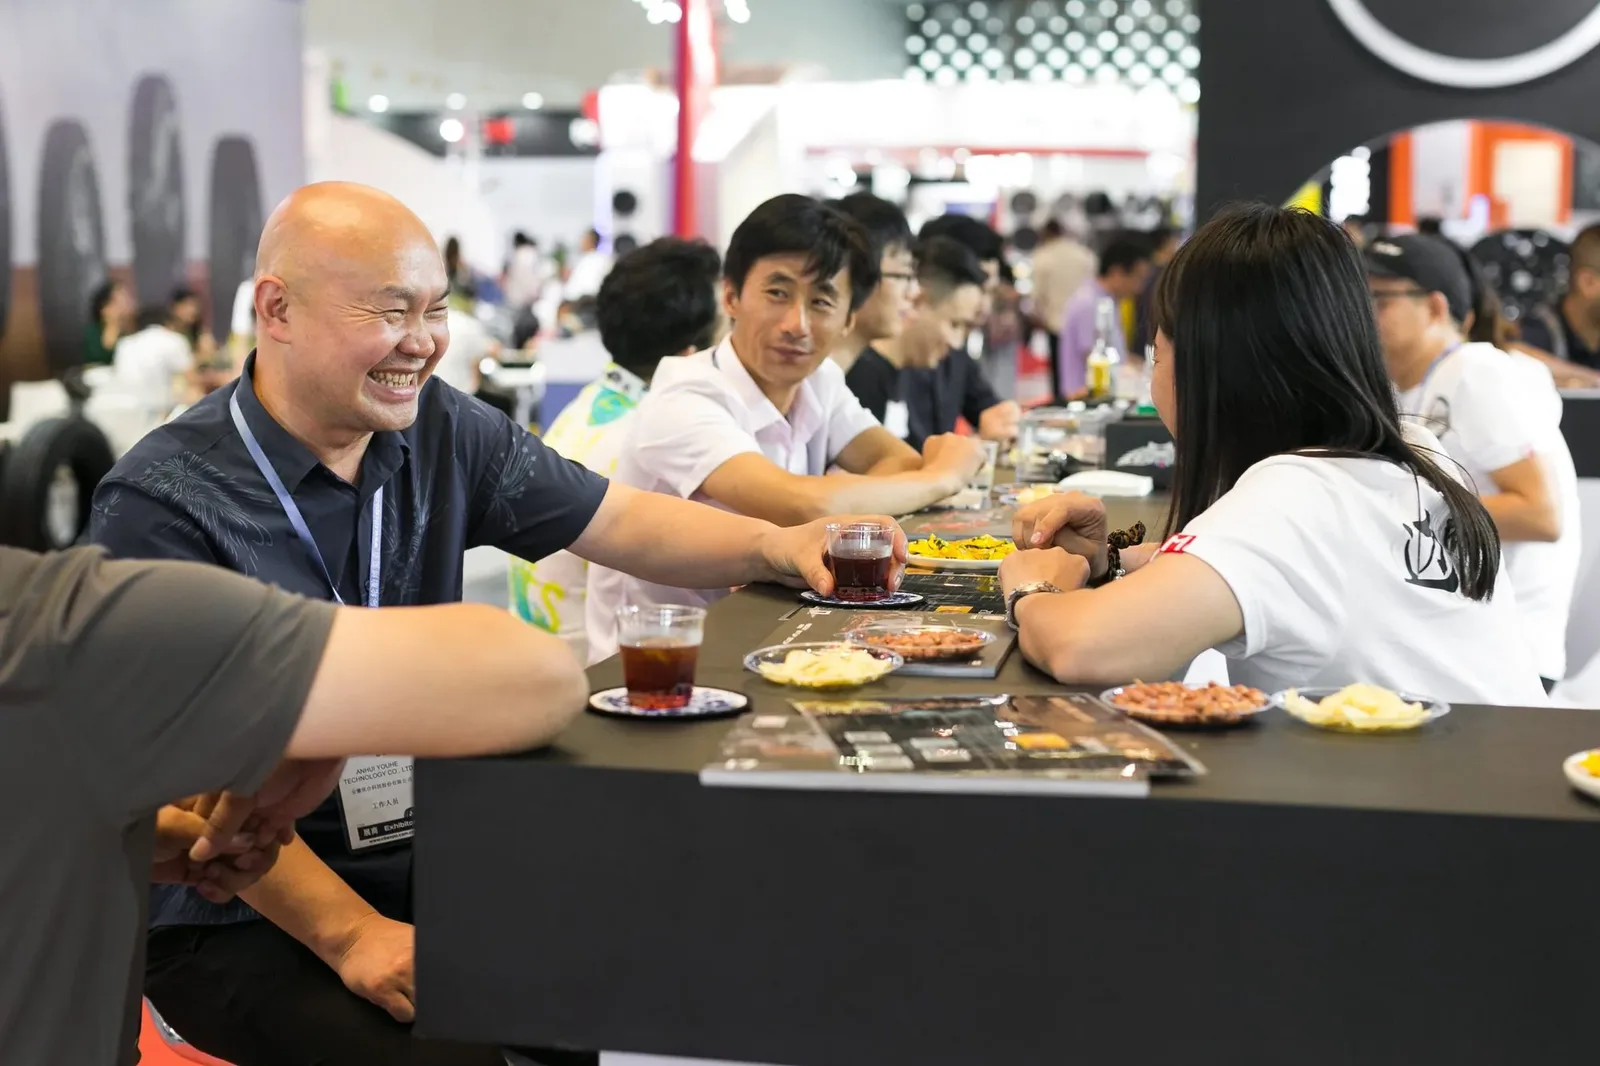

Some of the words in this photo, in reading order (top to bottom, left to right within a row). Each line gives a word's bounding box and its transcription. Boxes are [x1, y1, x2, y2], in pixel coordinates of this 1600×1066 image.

[356, 766, 375, 775] ANHUI
[376, 761, 398, 770] YOUHE
[343, 771, 387, 785] TECHNOLOGY
[372, 797, 399, 809] 工作人员
